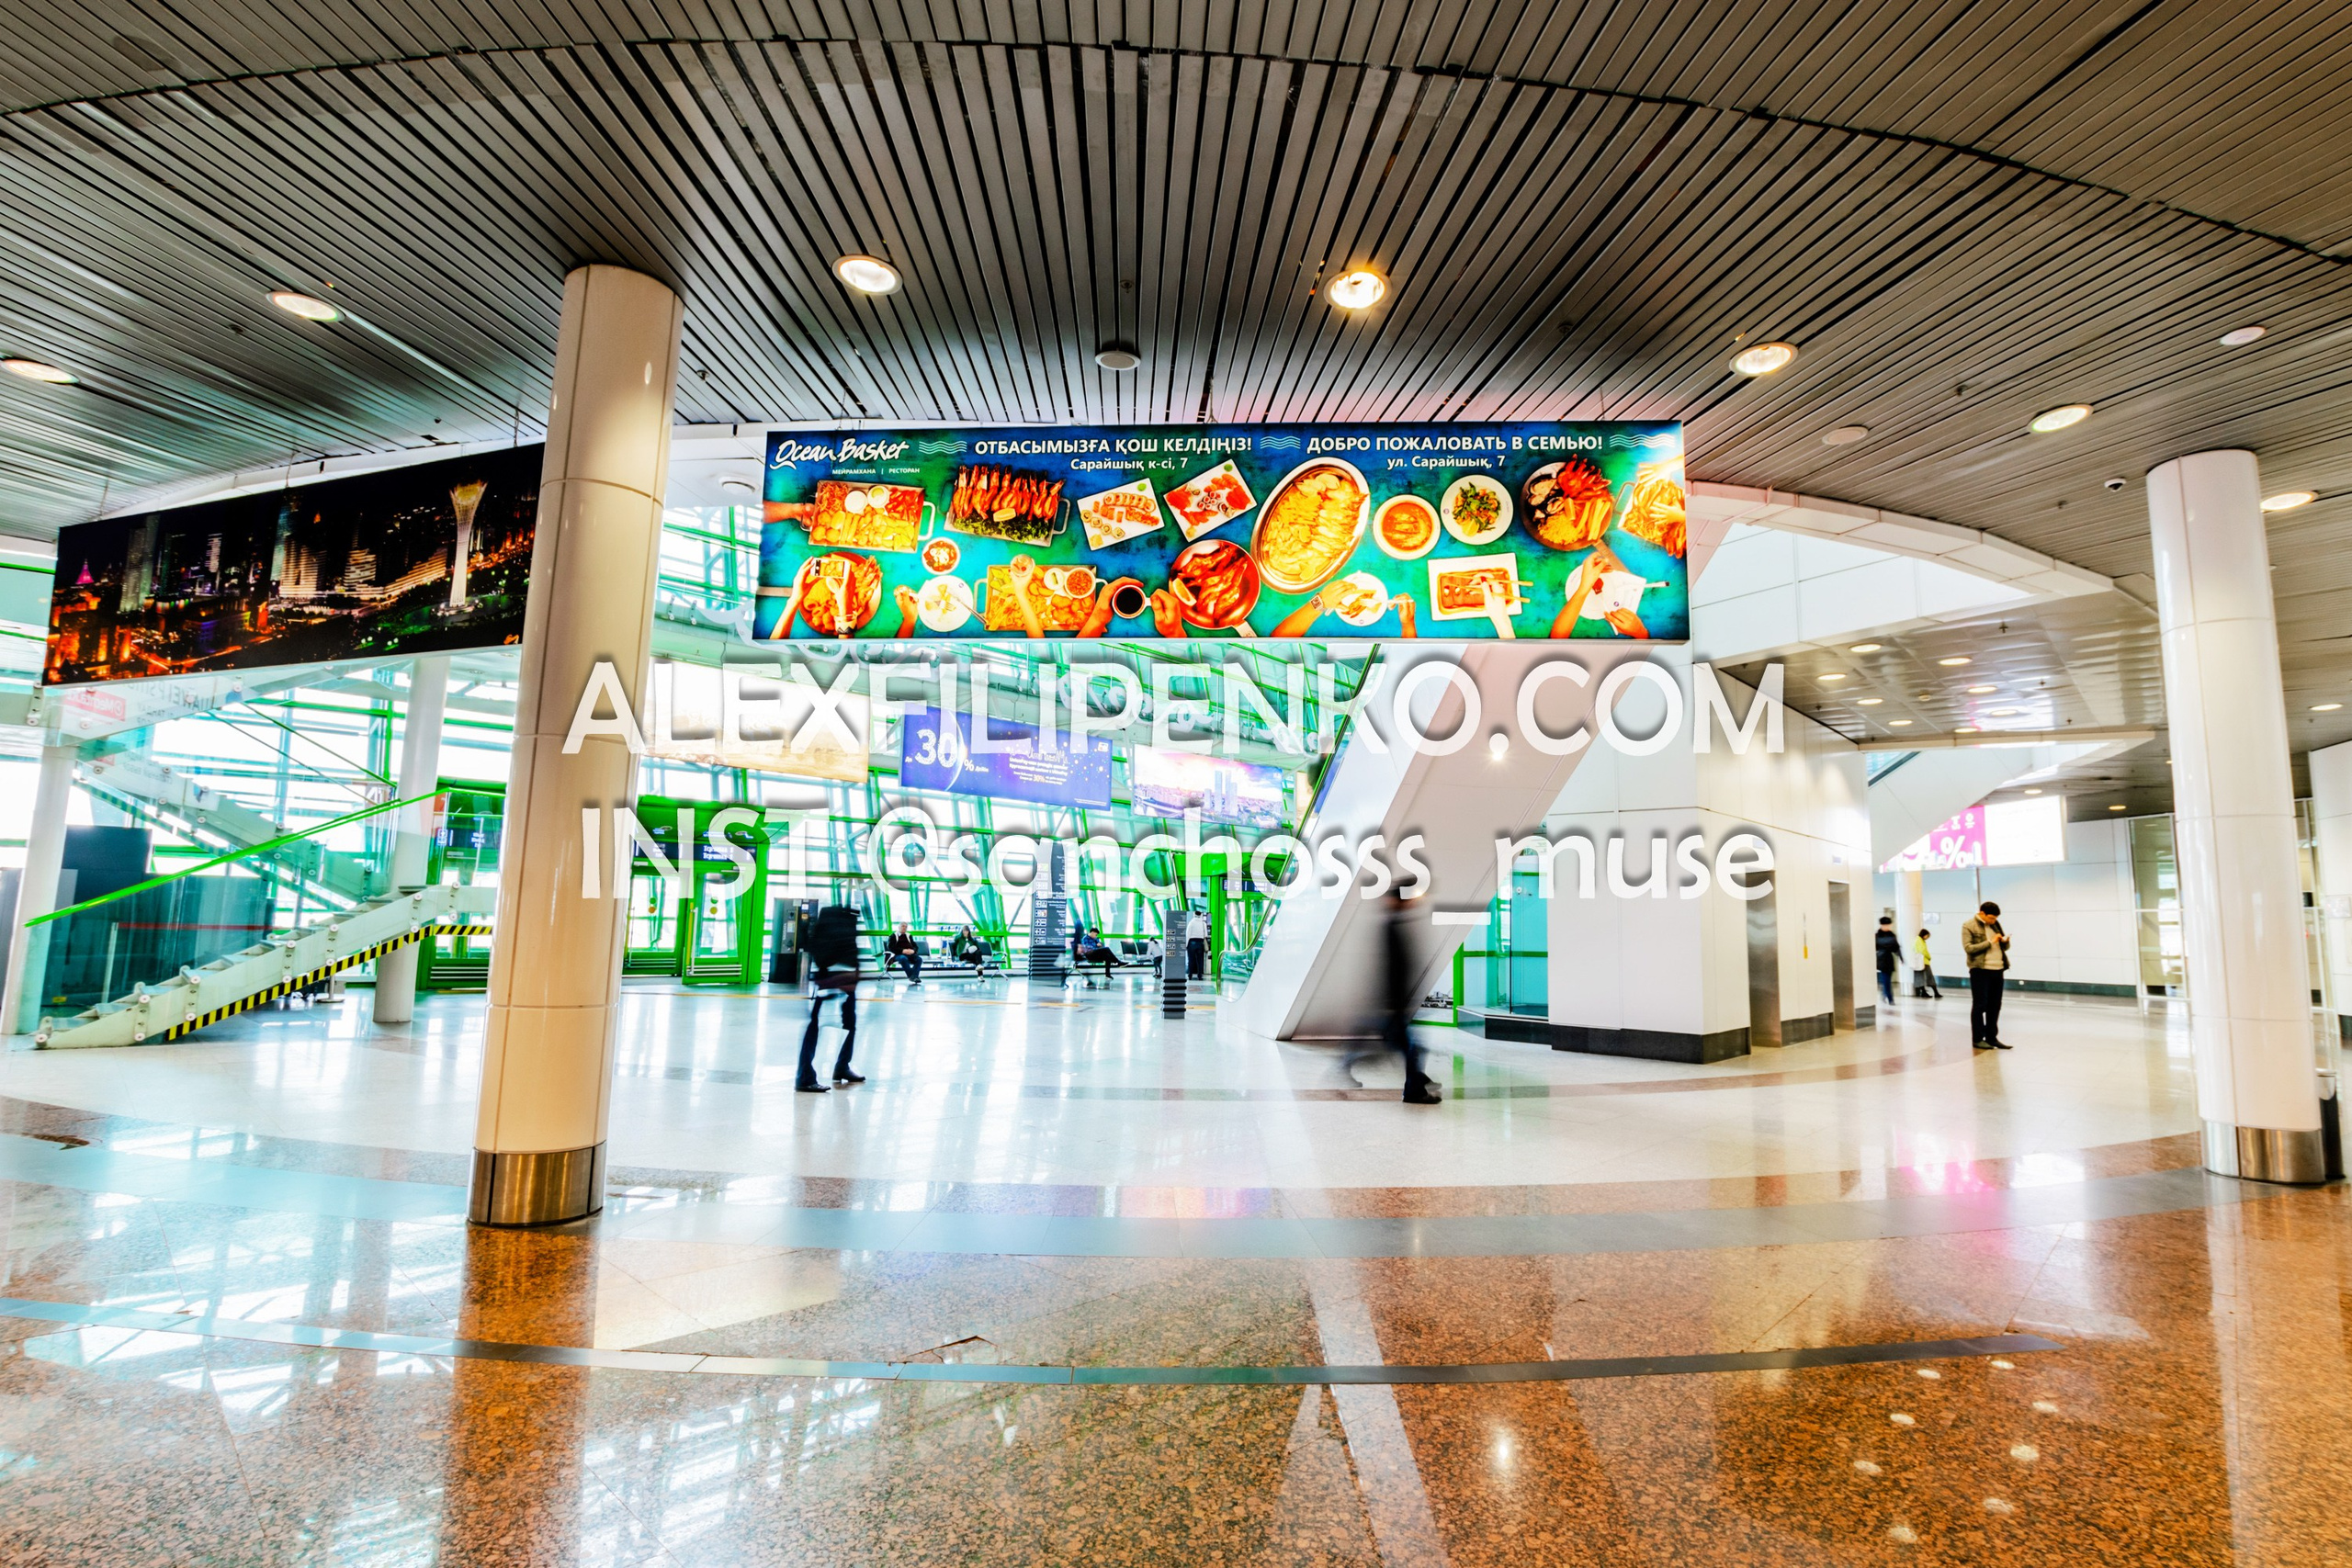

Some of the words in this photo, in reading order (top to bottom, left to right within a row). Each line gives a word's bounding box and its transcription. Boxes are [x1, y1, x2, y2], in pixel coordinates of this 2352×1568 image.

[769, 439, 836, 470] Ocean
[835, 438, 910, 464] Basket
[974, 438, 1110, 456] ОТБАСЫМЫЗҒА
[1114, 437, 1158, 456] ҚОШ
[1163, 436, 1252, 455] КЕЛДІҢІЗ!
[1306, 436, 1371, 454] ДОБРО
[1375, 435, 1507, 451] ПОЖАЛОВАТЬ
[1511, 435, 1523, 450] В
[1528, 435, 1603, 451] СЕМЬЮ!
[1070, 457, 1144, 472] Сарайшық
[1148, 458, 1176, 470] к-сі,
[1180, 457, 1188, 469] 7
[1386, 457, 1408, 470] ул.
[1411, 455, 1493, 470] Сарайшық,
[1497, 455, 1506, 468] 7
